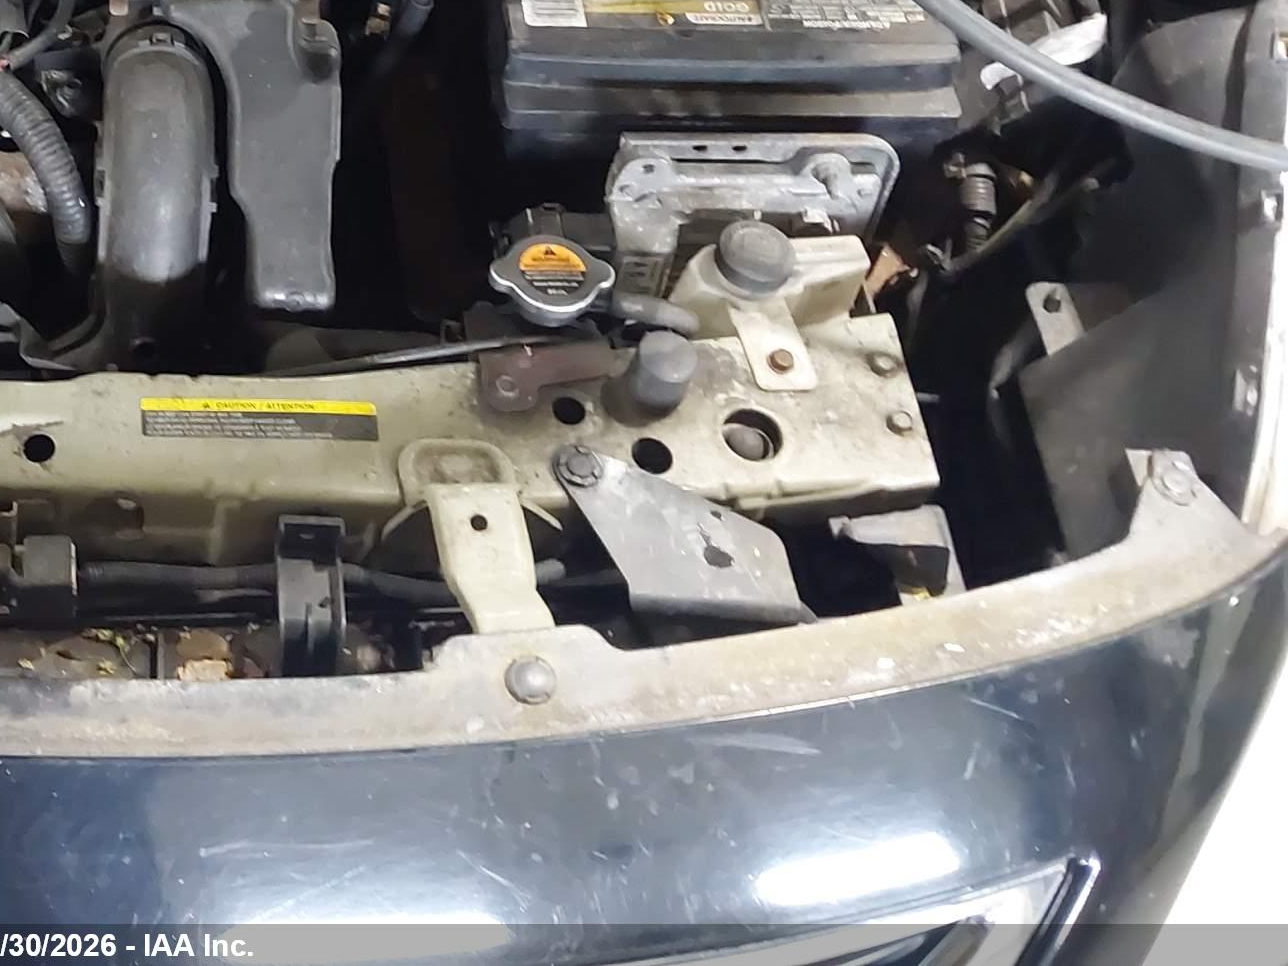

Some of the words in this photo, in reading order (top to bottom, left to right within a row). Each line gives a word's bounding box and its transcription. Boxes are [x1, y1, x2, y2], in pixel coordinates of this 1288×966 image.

[703, 1, 750, 12] GOLD
[215, 401, 257, 410] CAUTION
[266, 401, 315, 410] ATTENTION
